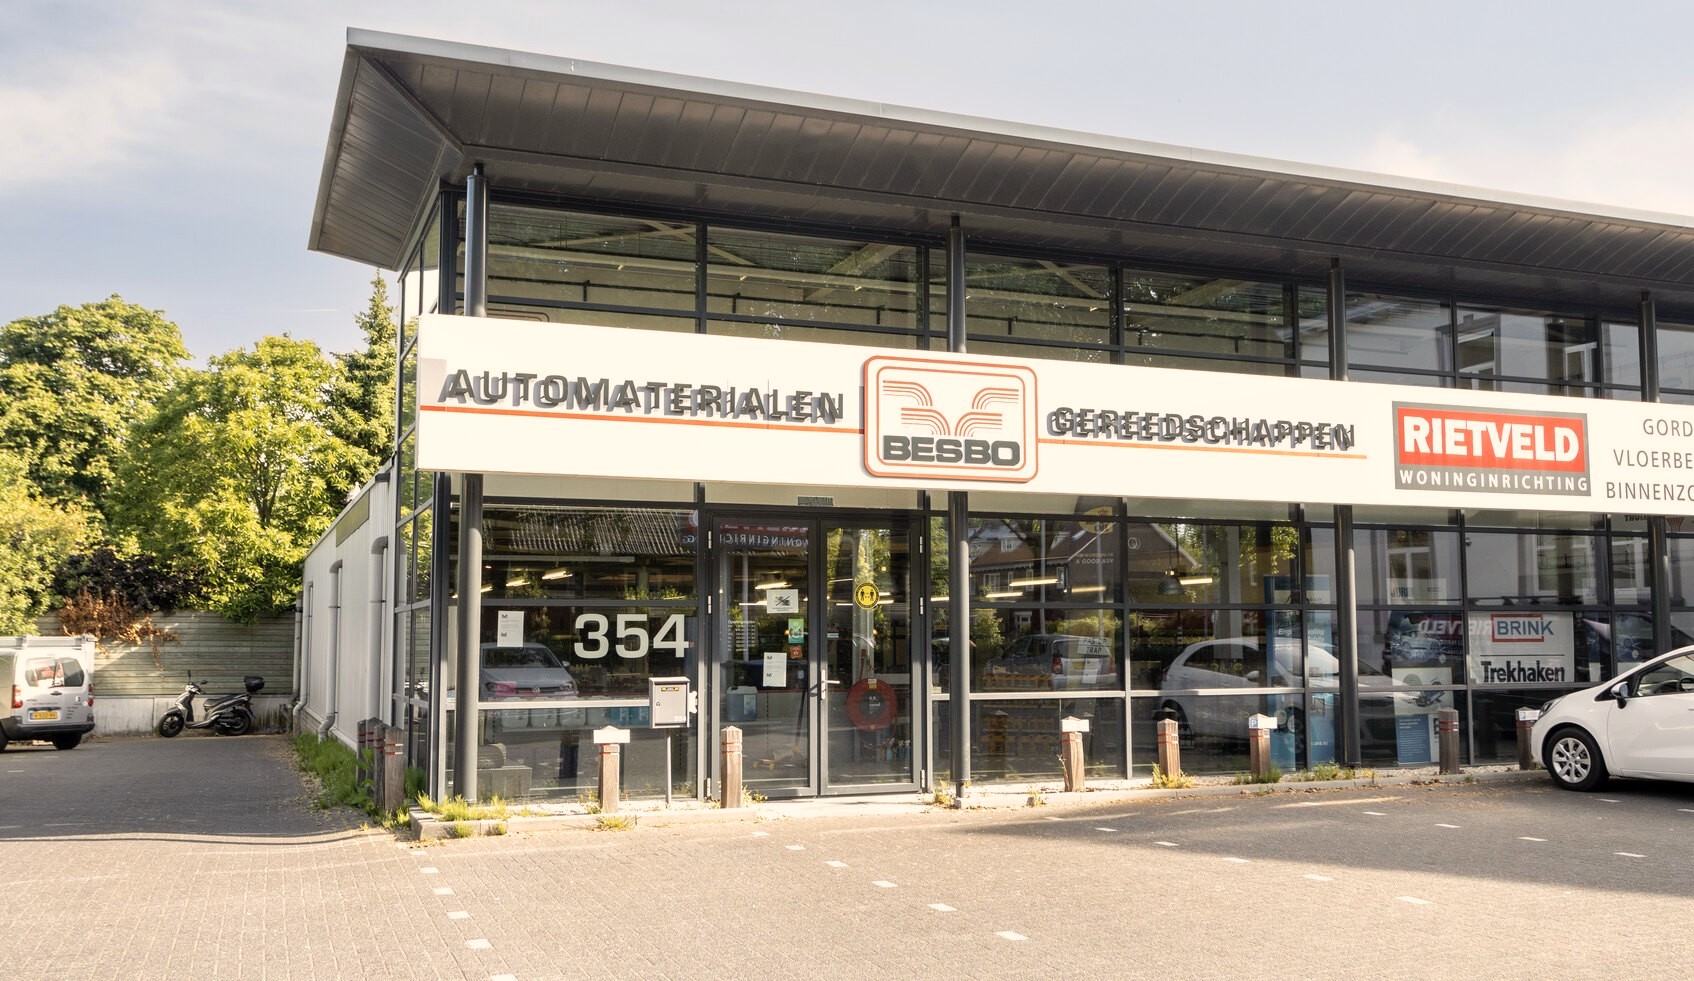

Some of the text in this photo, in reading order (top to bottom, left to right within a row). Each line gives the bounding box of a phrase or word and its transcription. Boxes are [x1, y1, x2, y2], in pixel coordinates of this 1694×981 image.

[446, 369, 844, 420] AUTOMATERIALEN
[1055, 407, 1356, 447] GEREEDSCHAPPEN
[1403, 415, 1580, 462] RIETVELD
[1643, 418, 1693, 437] GORD
[883, 435, 1020, 466] BESBO
[1613, 449, 1693, 469] VLOERBE
[1400, 469, 1588, 491] WONINGINRICHTING
[574, 614, 689, 658] 354
[1497, 621, 1554, 635] BRINK
[1481, 660, 1565, 682] Trekhaken
